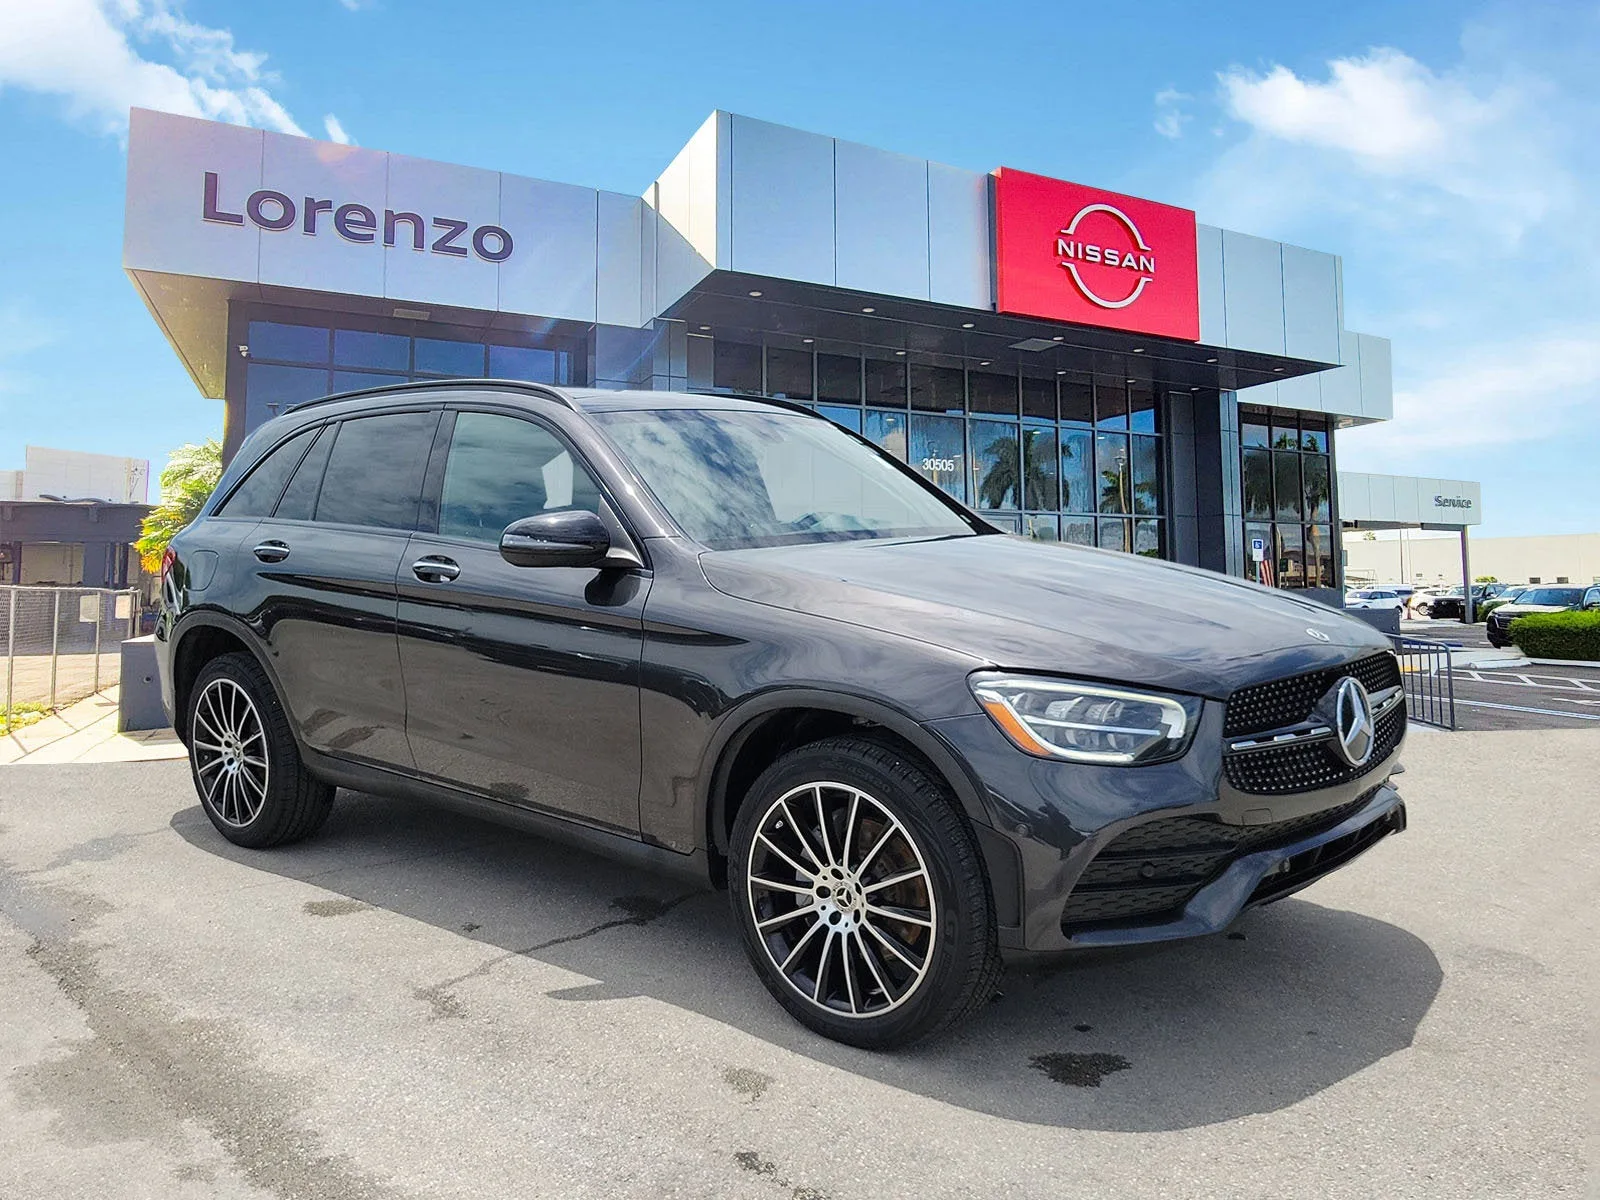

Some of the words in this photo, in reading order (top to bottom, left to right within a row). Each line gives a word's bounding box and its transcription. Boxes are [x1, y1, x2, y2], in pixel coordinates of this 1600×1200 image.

[202, 171, 514, 262] Lorenzo
[1057, 238, 1155, 273] NISSAN
[922, 458, 954, 471] 30505
[1434, 495, 1472, 508] Service
